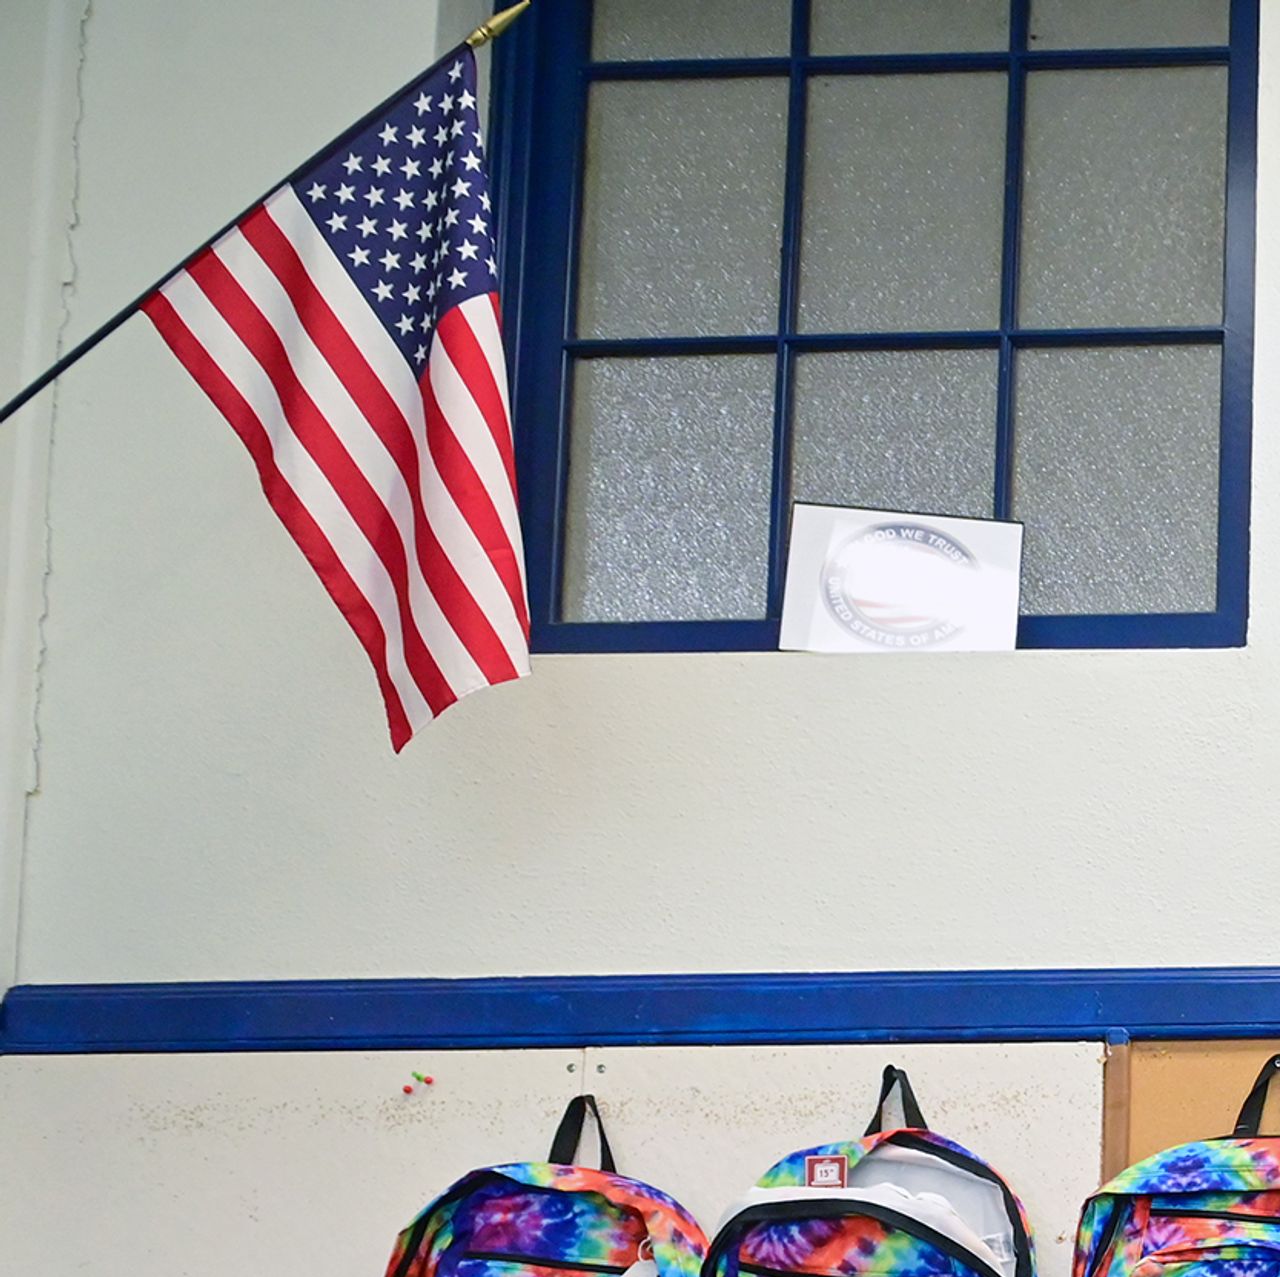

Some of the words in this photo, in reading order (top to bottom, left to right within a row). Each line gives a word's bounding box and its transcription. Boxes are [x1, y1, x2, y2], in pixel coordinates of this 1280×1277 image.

[900, 527, 924, 541] WE
[927, 534, 970, 567] TRUST
[850, 618, 906, 647] STATES
[909, 633, 931, 646] OF
